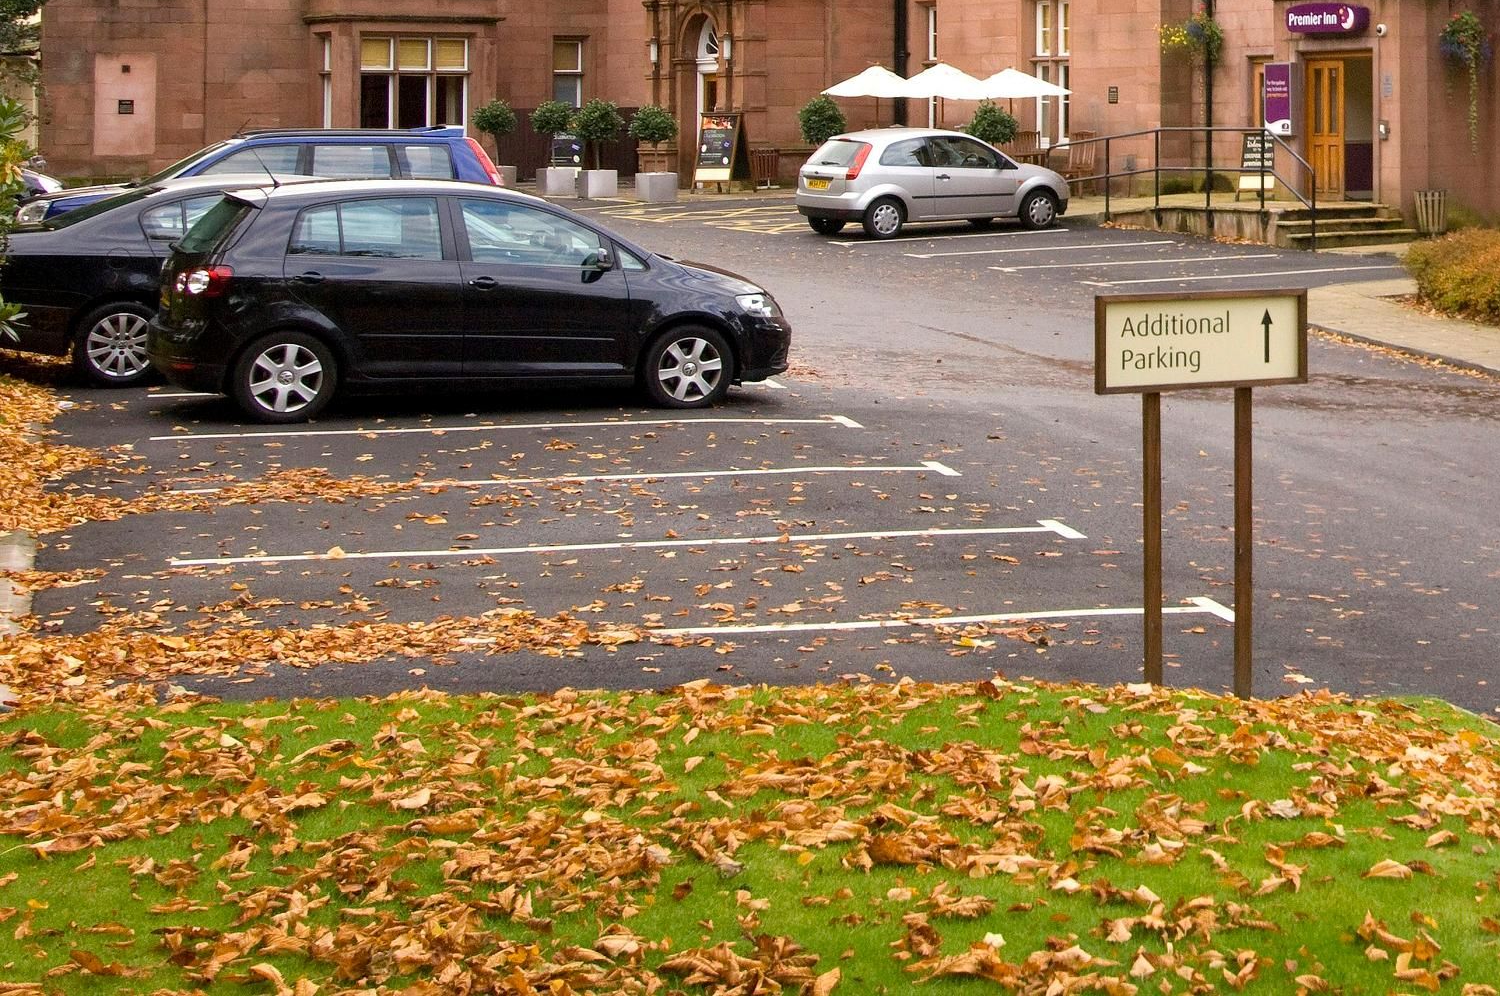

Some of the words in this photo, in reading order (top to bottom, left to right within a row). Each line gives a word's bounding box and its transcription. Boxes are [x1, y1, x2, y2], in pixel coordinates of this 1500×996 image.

[1288, 12, 1322, 27] Premier
[1323, 11, 1337, 25] Inn
[1121, 309, 1230, 338] Additional
[1121, 345, 1201, 373] Parking
